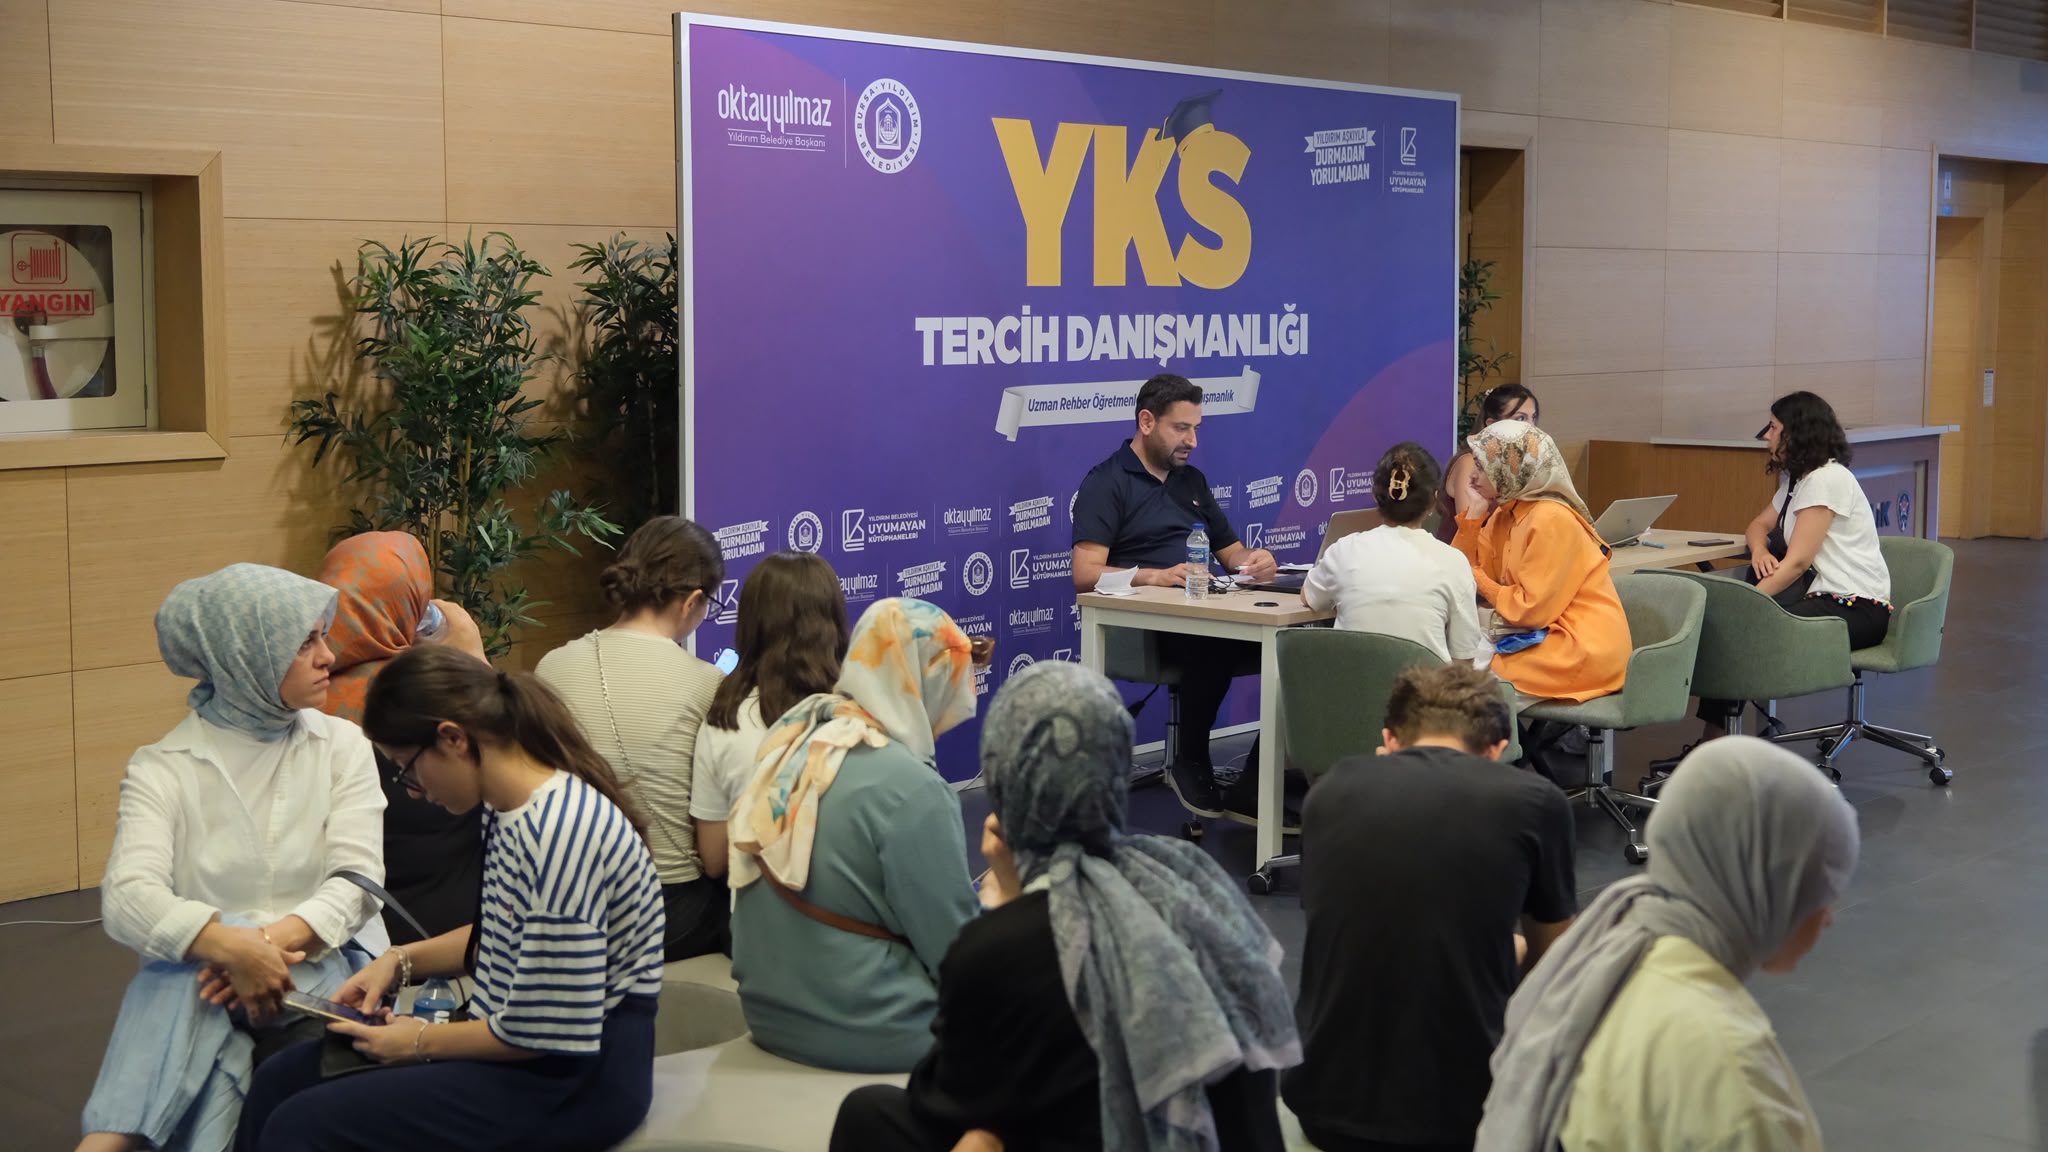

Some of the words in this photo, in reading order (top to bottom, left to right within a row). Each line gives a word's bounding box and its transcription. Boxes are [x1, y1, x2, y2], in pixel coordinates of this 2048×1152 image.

[857, 88, 875, 129] BURSA
[881, 82, 919, 128] YILDIRIM
[728, 132, 758, 143] Yıldırım
[760, 134, 793, 147] Belediye
[795, 136, 826, 148] Başkanı
[1315, 145, 1365, 166] DURMADAN
[1310, 163, 1370, 186] YORULMADAN
[1389, 176, 1427, 187] UYUMAYAN
[991, 117, 1252, 290] YKS
[0, 294, 91, 312] YANGIN
[915, 305, 1060, 367] TERCİH
[1067, 303, 1308, 368] DANIŞMANLIĞI
[1028, 398, 1059, 412] Uzman
[1060, 396, 1091, 411] Rehber
[1092, 392, 1137, 410] Öğretmenl
[1202, 389, 1235, 405] ışmanlık
[1346, 478, 1374, 488] UYUMA
[1248, 493, 1280, 509] YORULMADAN
[1015, 506, 1048, 522] DURMADAN
[868, 520, 926, 535] UYUMAYAN
[1012, 515, 1051, 533] YORULMADAN
[720, 531, 761, 549] DURMADAN
[868, 532, 919, 543] KÜTÜPHANELERİ
[1264, 531, 1306, 544] UYUMAYAN
[721, 541, 765, 560] ORULMADAN
[1033, 558, 1072, 572] UYUMAY
[904, 571, 939, 589] DURMADAN
[901, 581, 943, 598] YORULMADAN
[961, 621, 993, 634] MAYAN
